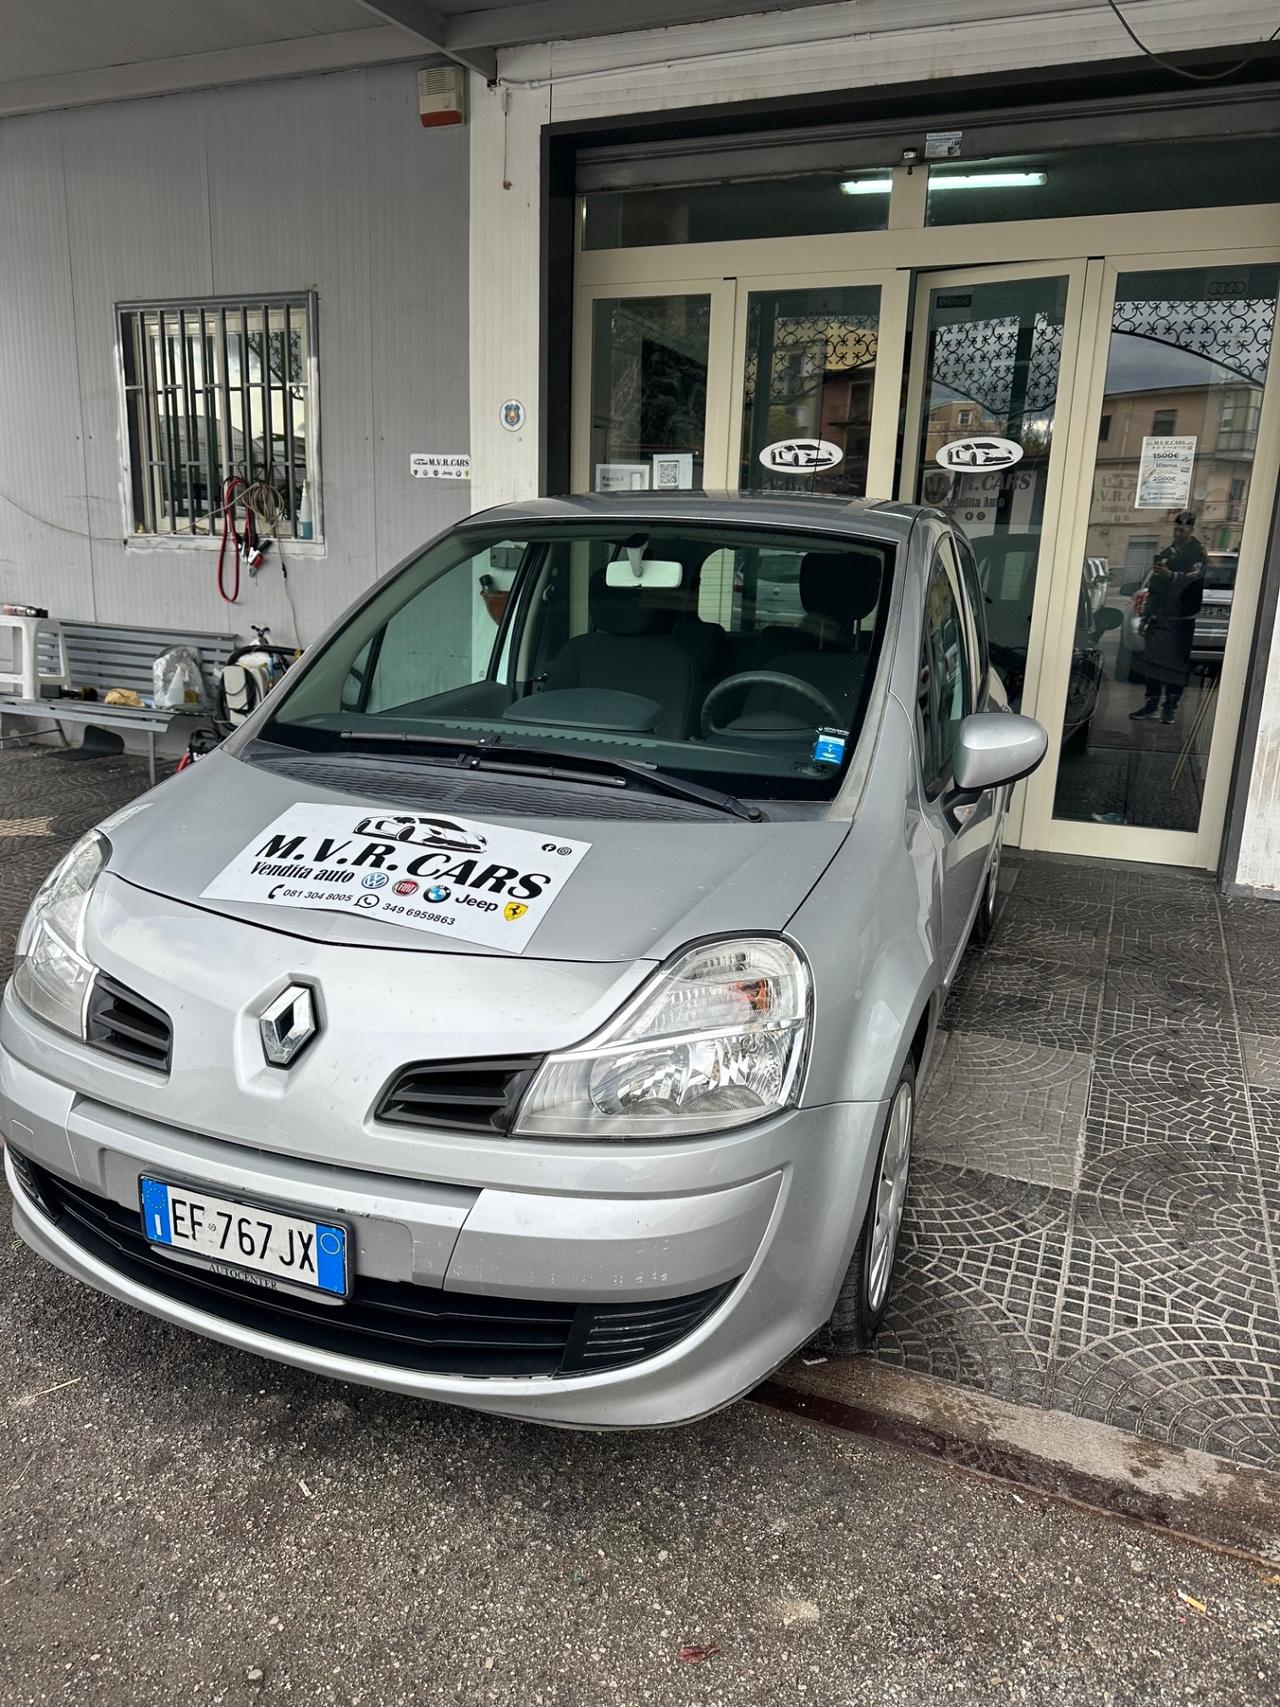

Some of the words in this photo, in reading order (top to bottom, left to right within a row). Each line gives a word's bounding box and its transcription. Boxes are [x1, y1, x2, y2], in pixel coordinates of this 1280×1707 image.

[250, 861, 313, 880] Vendita
[314, 867, 356, 883] auto
[282, 889, 303, 898] 081
[304, 891, 324, 899] 304
[325, 893, 354, 902] 8005
[455, 894, 499, 913] Jeep
[382, 902, 405, 914] 349
[406, 908, 456, 926] 6959863
[208, 1263, 278, 1290] AUTOCENTER
